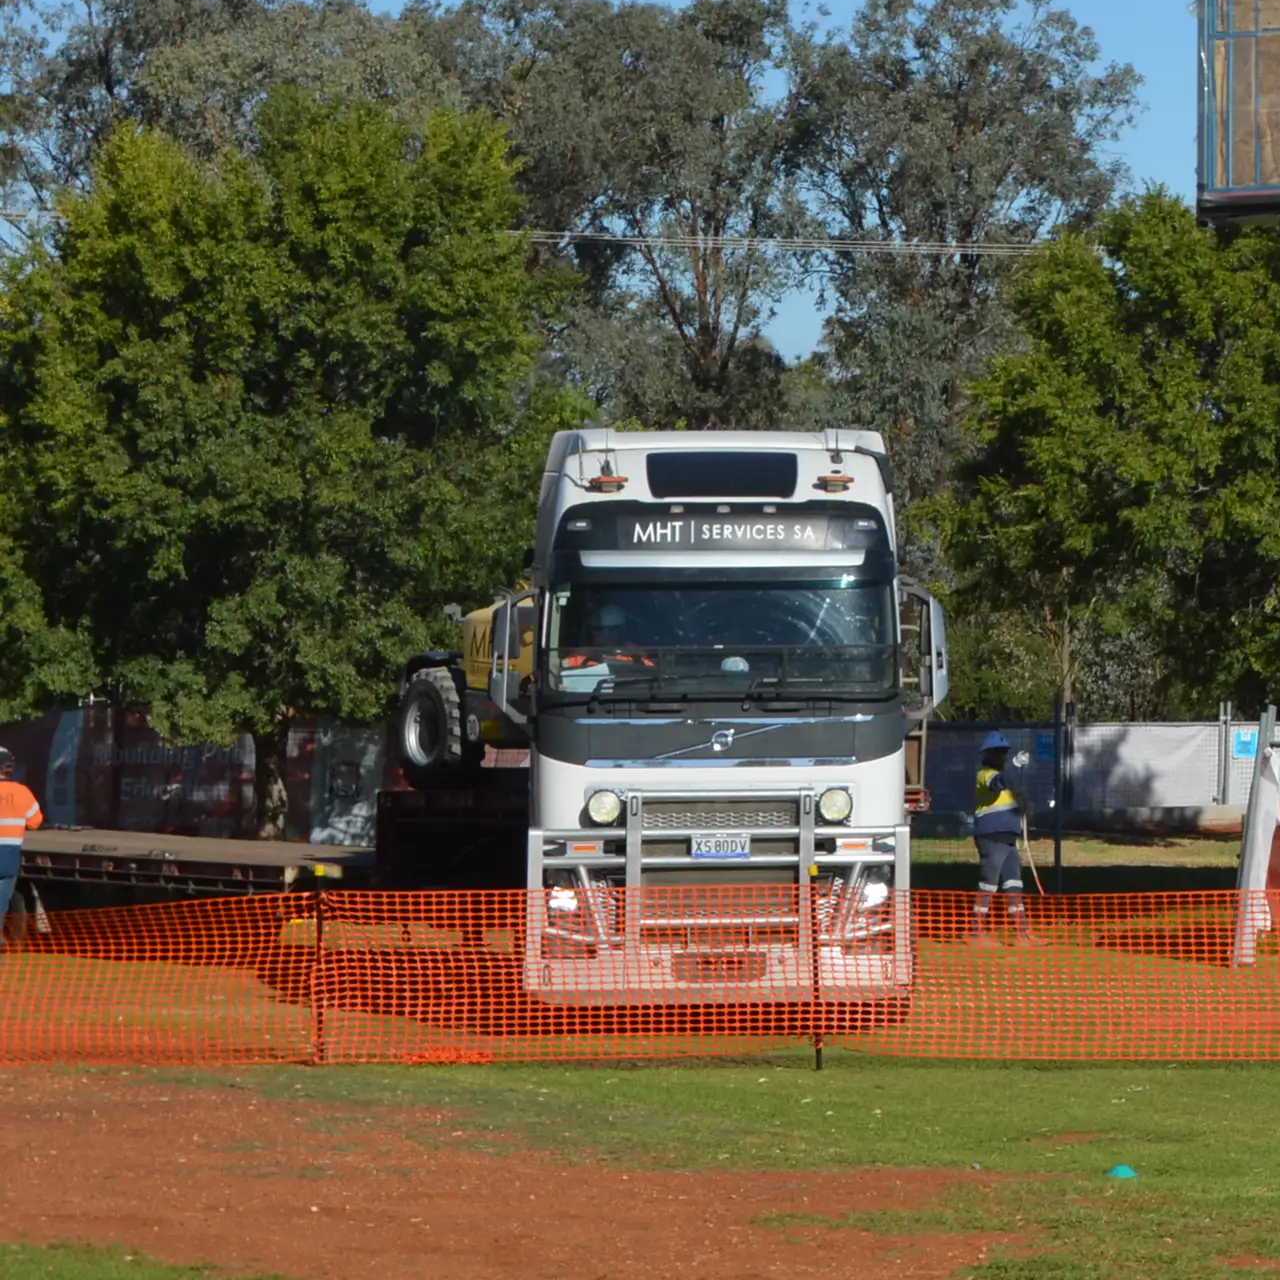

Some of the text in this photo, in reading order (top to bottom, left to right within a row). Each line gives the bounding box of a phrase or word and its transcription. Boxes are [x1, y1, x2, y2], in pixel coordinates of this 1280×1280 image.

[633, 522, 815, 543] MHT SERVICES SA
